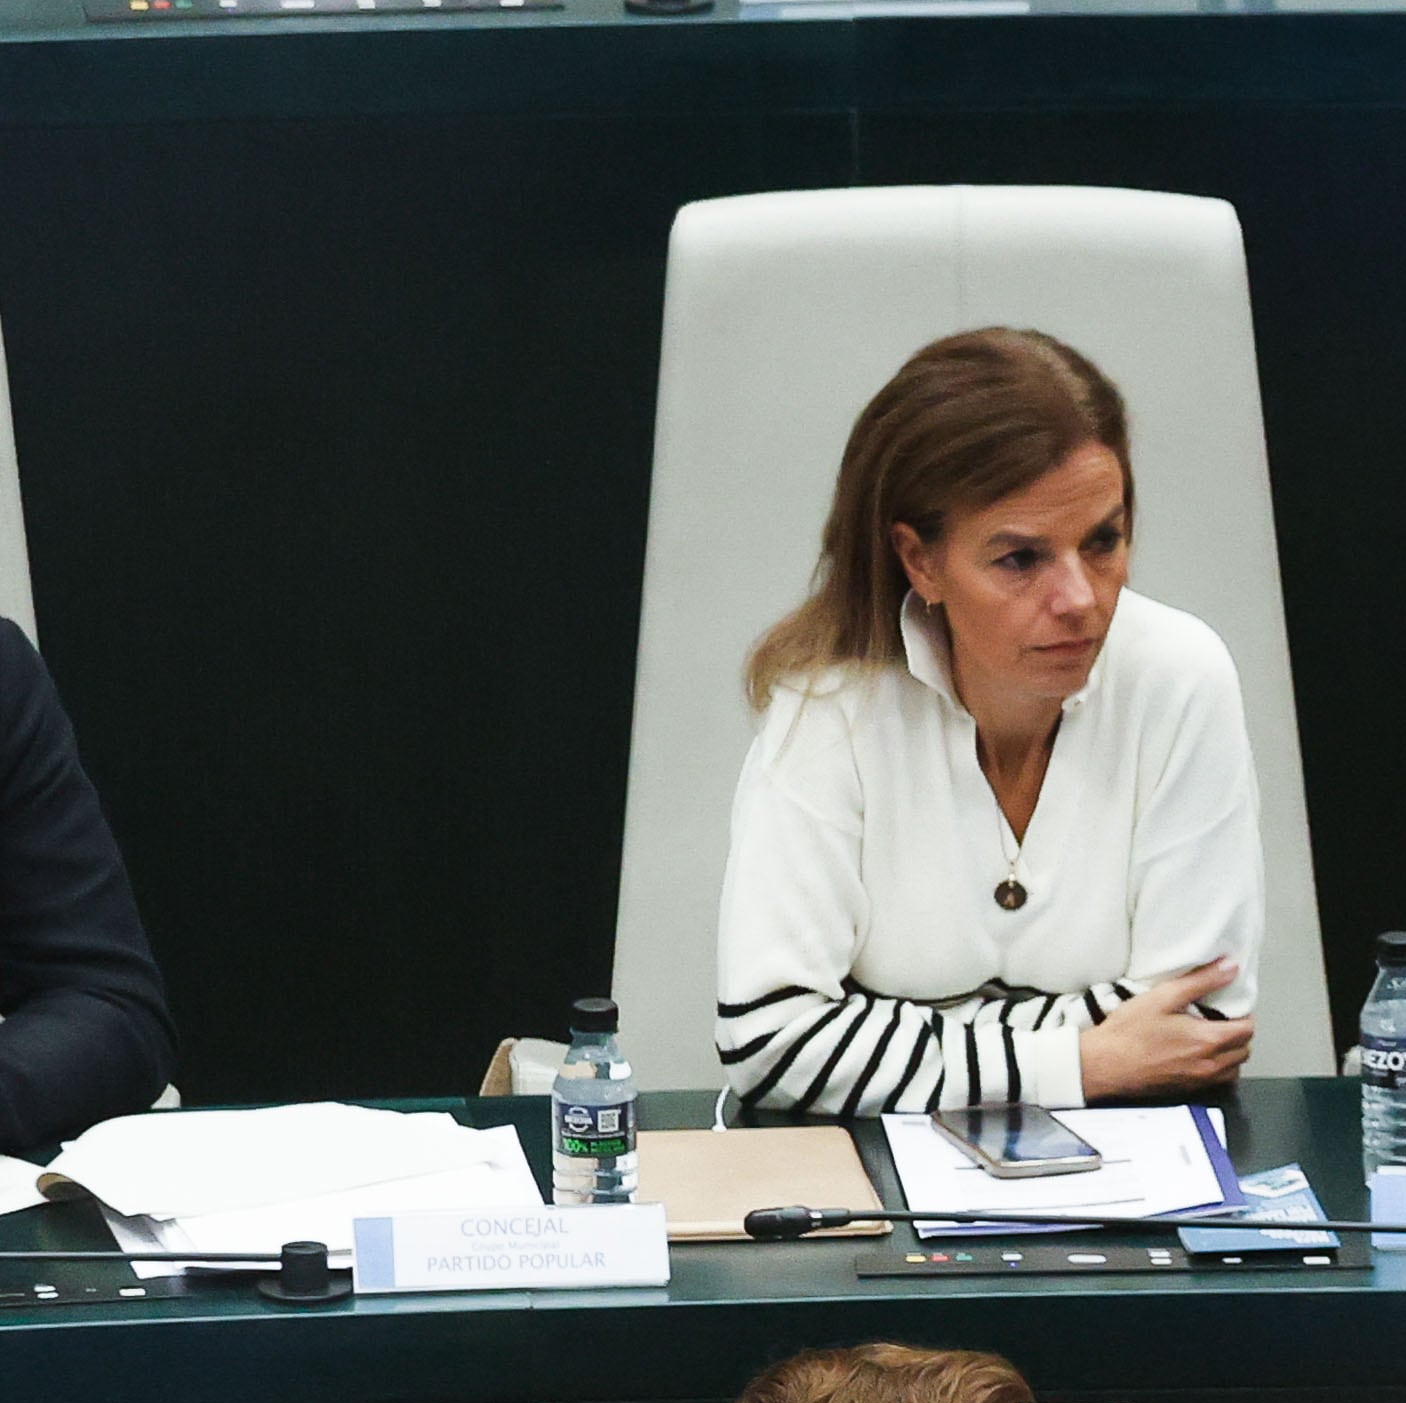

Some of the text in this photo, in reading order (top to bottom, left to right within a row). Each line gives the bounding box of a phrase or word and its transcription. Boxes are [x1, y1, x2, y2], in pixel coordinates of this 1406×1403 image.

[460, 1216, 569, 1237] CONCEJAL
[427, 1250, 607, 1272] PARTIDO POPULAR
